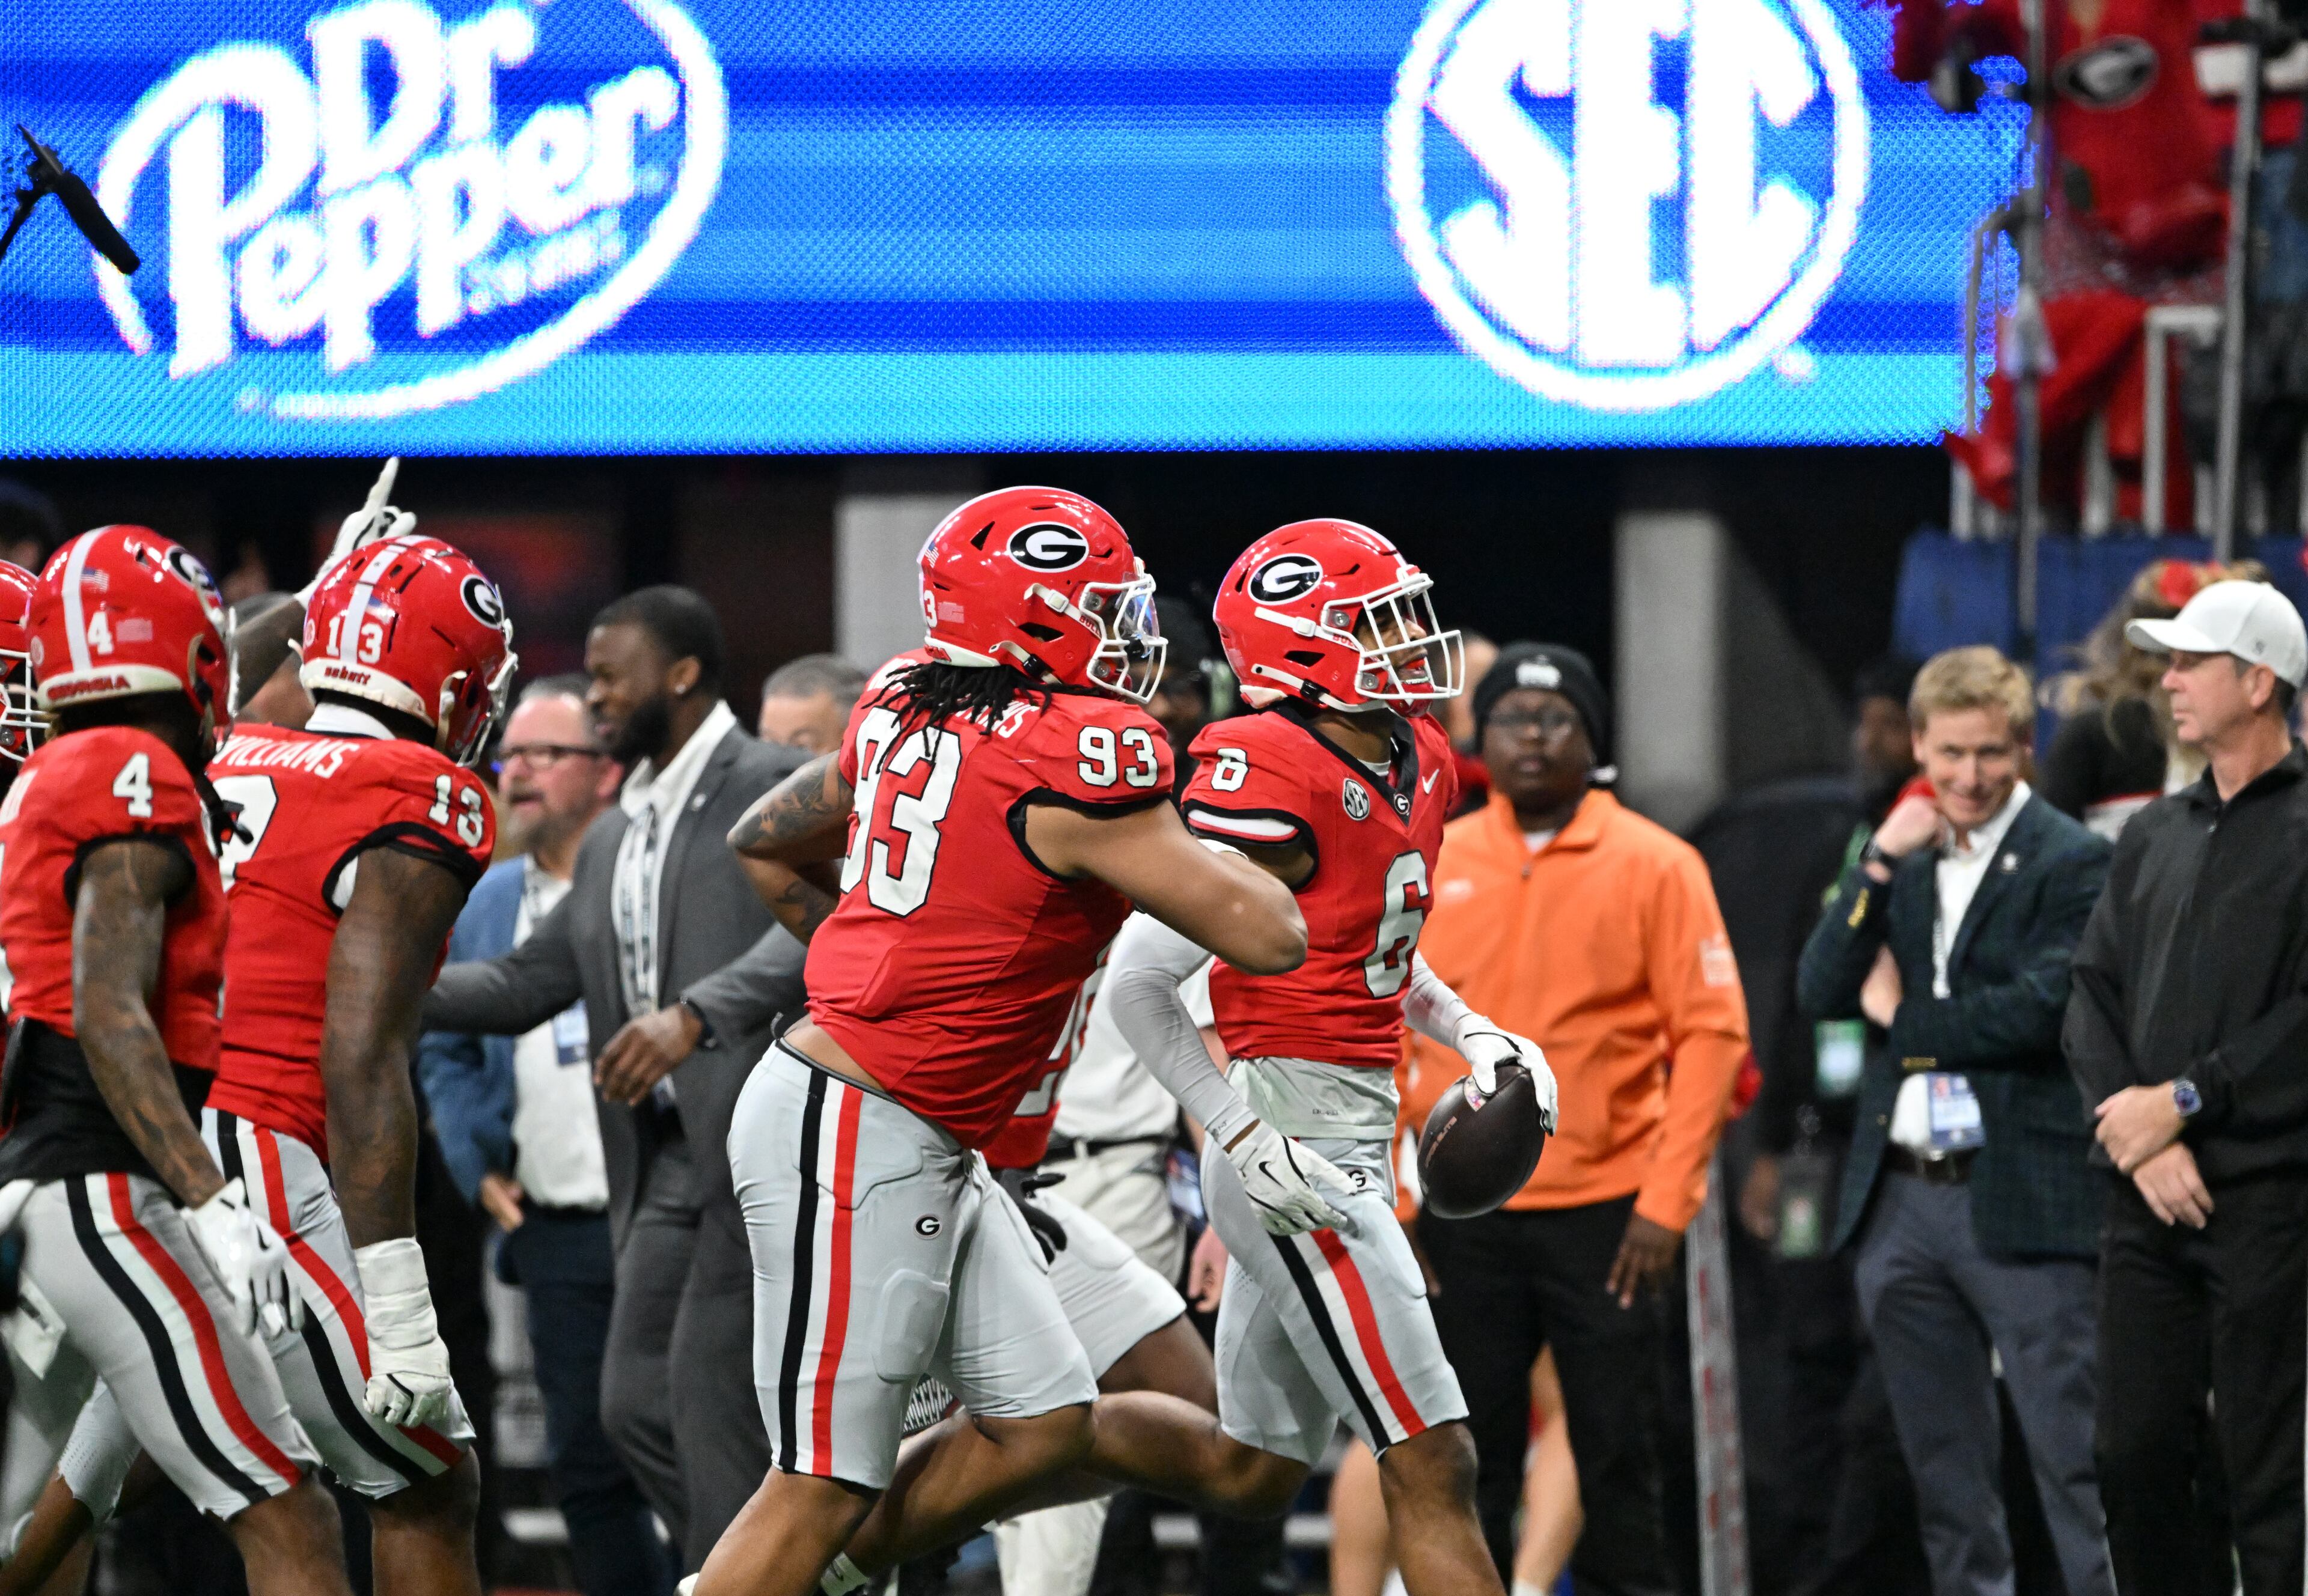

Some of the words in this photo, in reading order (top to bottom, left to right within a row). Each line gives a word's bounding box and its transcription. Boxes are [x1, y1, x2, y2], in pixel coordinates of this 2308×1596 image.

[306, 0, 537, 196] Dr
[96, 40, 680, 380] Pepper
[1427, 0, 1820, 367] SEC
[88, 611, 114, 655] 4
[112, 752, 153, 818] 4
[1078, 726, 1158, 788] 93
[1211, 748, 1248, 791] 6
[427, 775, 484, 847] 13
[840, 705, 962, 918] 93
[1345, 780, 1369, 818] SEC
[1364, 850, 1428, 999] 6
